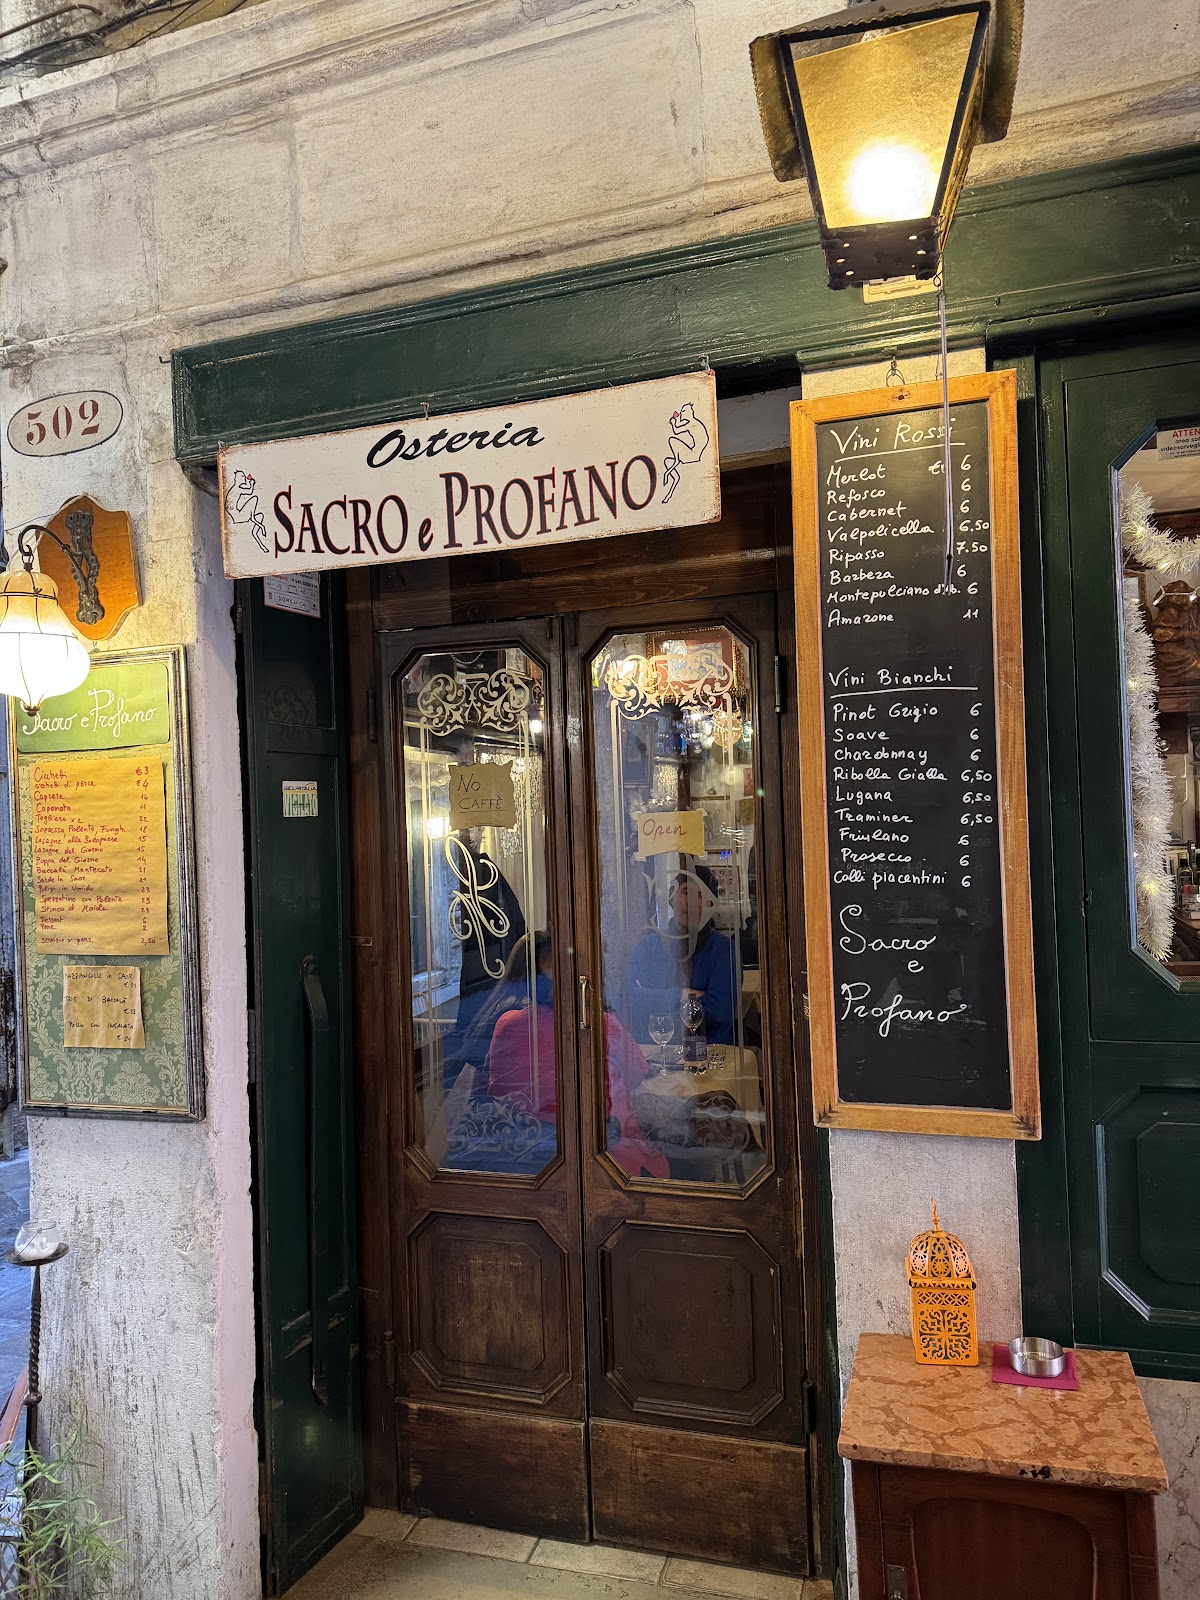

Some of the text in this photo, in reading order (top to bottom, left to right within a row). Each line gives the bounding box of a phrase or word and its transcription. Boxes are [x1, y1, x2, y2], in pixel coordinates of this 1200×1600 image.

[27, 400, 100, 445] 502
[366, 422, 545, 469] Osteria
[831, 418, 956, 454] Vini Rossi
[827, 464, 886, 488] Merlot
[961, 455, 972, 471] 6
[827, 478, 971, 508] Refosco 6
[273, 455, 658, 558] SACRO e PROFANO
[828, 500, 970, 522] Cabernet 6
[828, 519, 934, 546] Valpolicella
[829, 549, 885, 568] Ripasso
[830, 565, 967, 585] Barbera 6
[827, 585, 929, 604] Montepulciano
[967, 582, 978, 595] 6
[963, 609, 979, 619] 11
[829, 666, 953, 688] Vini Bianchi
[81, 715, 89, 727] e
[88, 688, 158, 738] Profano
[833, 703, 983, 723] Pinot Grigio 6
[833, 728, 979, 742] Soave 6
[971, 749, 982, 761] 6
[143, 781, 149, 790] 4
[457, 774, 481, 792] No
[834, 767, 993, 784] Ribolla Gialla 6,50
[34, 791, 65, 802] Caprese
[459, 795, 502, 809] CAFFÈ
[835, 786, 991, 806] Lugana 6,50
[36, 803, 71, 813] Caponata
[835, 809, 993, 826] Traminer 6,50
[100, 825, 126, 835] Funghi
[643, 819, 687, 837] Open
[839, 827, 970, 846] Friulano 6
[841, 848, 970, 867] Prosecco 6
[834, 870, 972, 890] Colli piacentini 6
[840, 904, 937, 954] Sacro
[908, 960, 924, 973] e
[841, 982, 967, 1037] Profano
